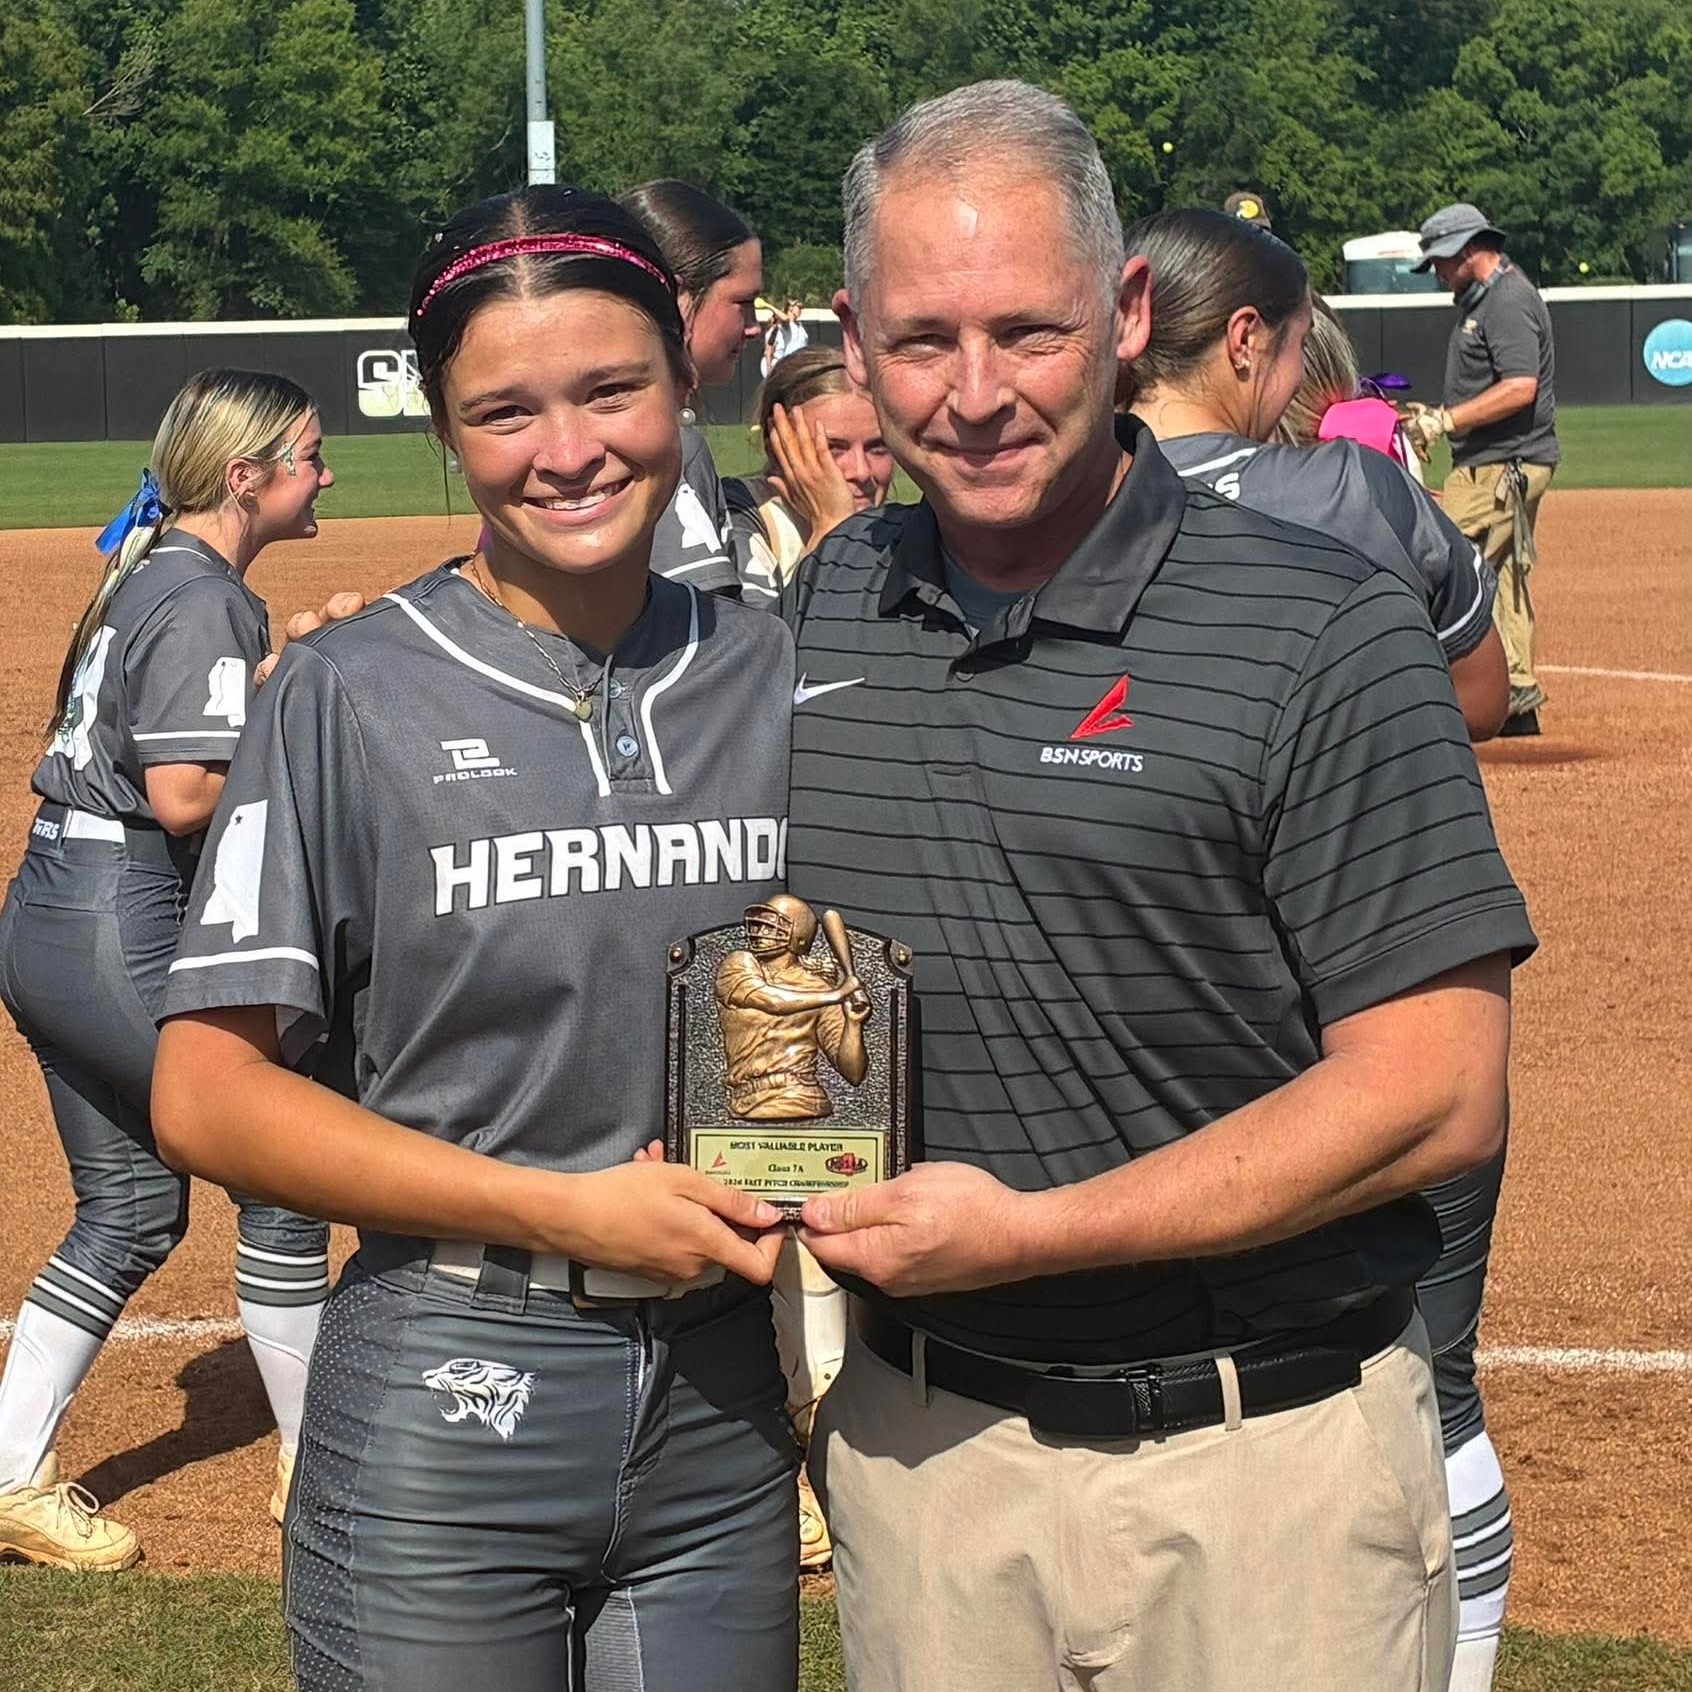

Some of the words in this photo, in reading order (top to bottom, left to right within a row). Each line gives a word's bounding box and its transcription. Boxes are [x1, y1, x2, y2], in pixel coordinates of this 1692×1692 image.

[1651, 350, 1692, 370] NCA
[429, 817, 788, 916] HERNAND
[808, 1142, 843, 1152] PLAYER
